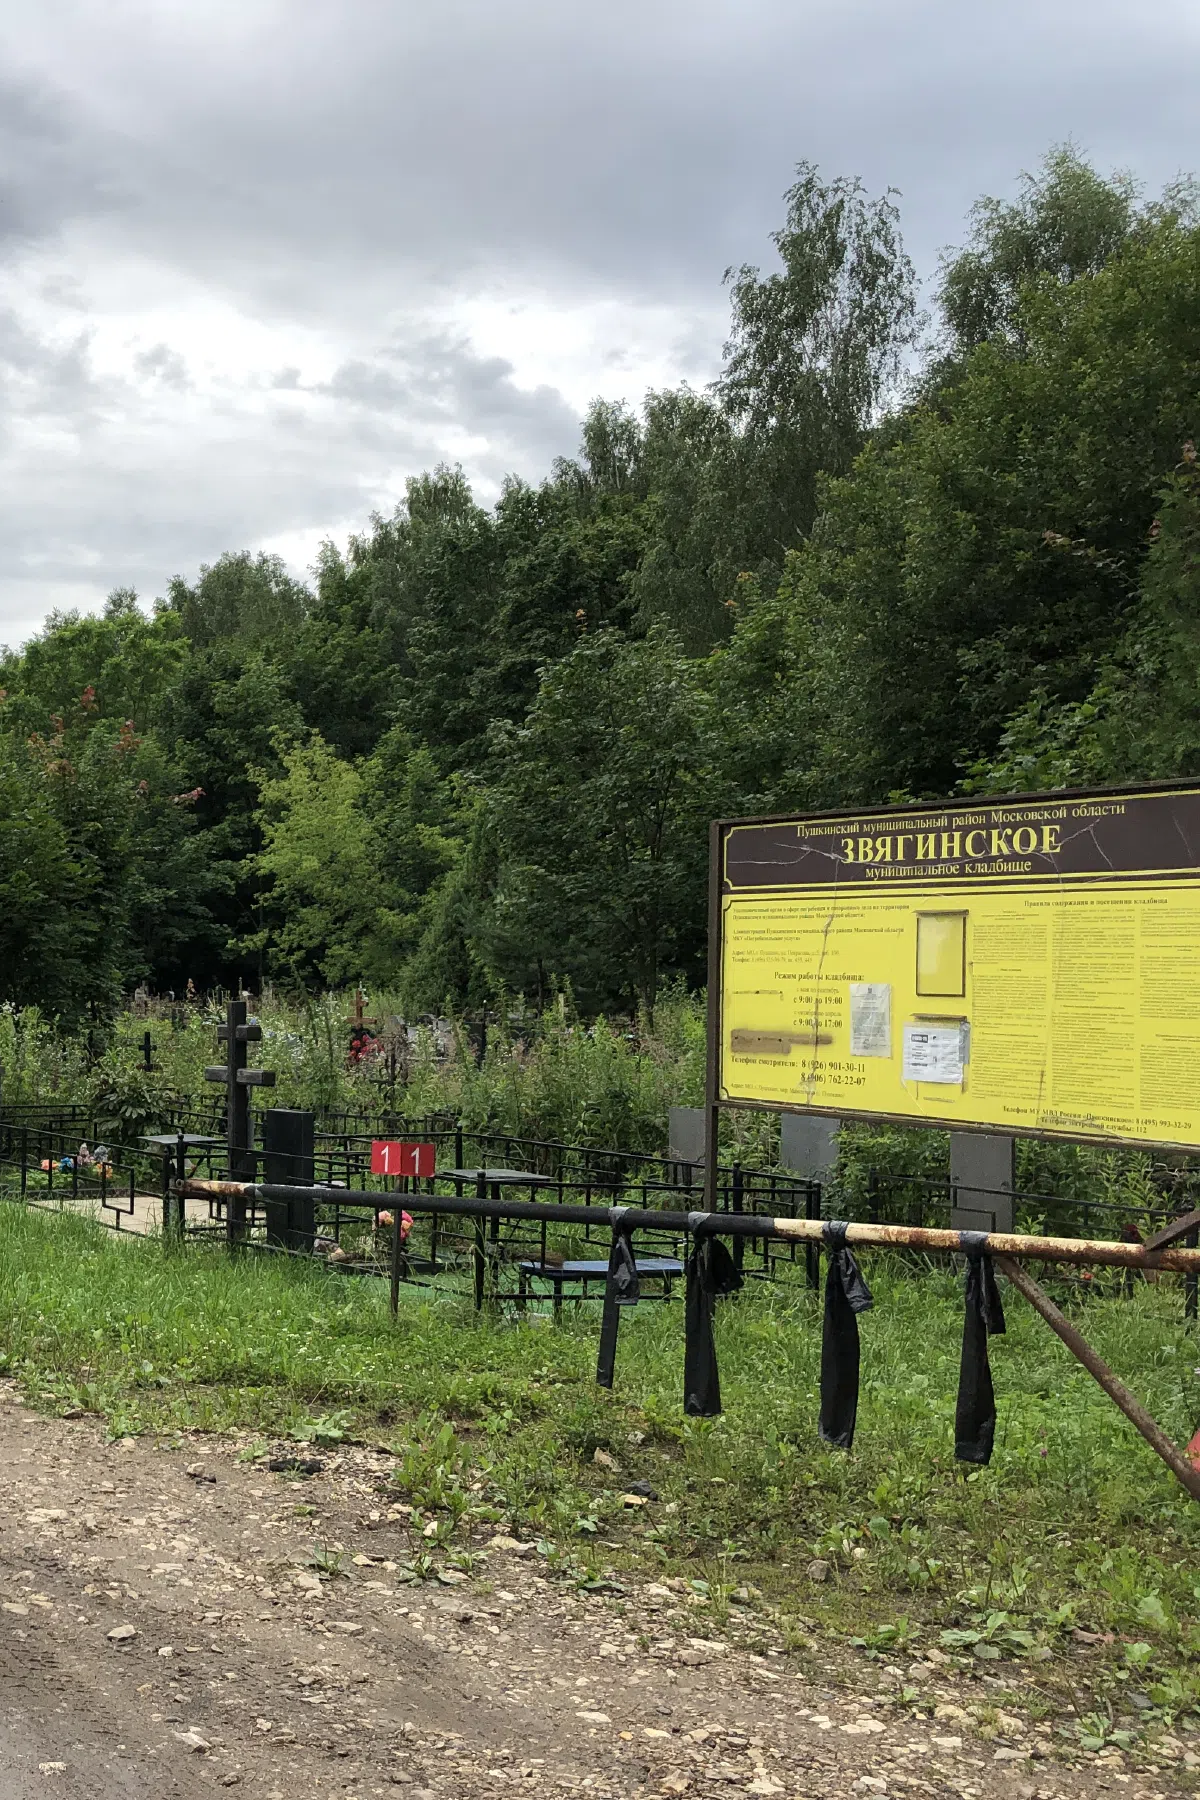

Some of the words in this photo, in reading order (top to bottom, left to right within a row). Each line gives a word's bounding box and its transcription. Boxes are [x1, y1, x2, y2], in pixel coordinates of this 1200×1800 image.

[797, 822, 860, 838] Пушкинский
[862, 815, 949, 835] муниципальный
[952, 812, 986, 830] район
[991, 806, 1067, 824] Московской
[1071, 804, 1125, 819] области
[841, 824, 1061, 864] ЗВЯГИНСКОЕ
[865, 863, 960, 881] муниципальное
[965, 859, 1031, 875] кладбище
[1024, 899, 1050, 908] Правила
[774, 971, 796, 980] Режим
[798, 971, 823, 981] работы
[825, 971, 865, 981] кладбища:
[798, 996, 813, 1004] 9:00
[824, 996, 843, 1005] 19:00
[798, 1018, 812, 1027] 9:00
[824, 1018, 843, 1028] 17:00
[731, 1055, 757, 1065] Телефон
[758, 1059, 798, 1067] смотрителя:
[828, 1061, 866, 1073] 901-30-11
[828, 1074, 867, 1086] 762-22-07
[1003, 1105, 1028, 1115] Телефон
[1042, 1108, 1058, 1117] МВД
[1059, 1110, 1082, 1119] России
[1141, 1118, 1158, 1127] (495)
[1159, 1119, 1192, 1130] 993-32-29
[1136, 1125, 1148, 1134] 112
[381, 1145, 389, 1172] 1
[411, 1147, 419, 1174] 1
